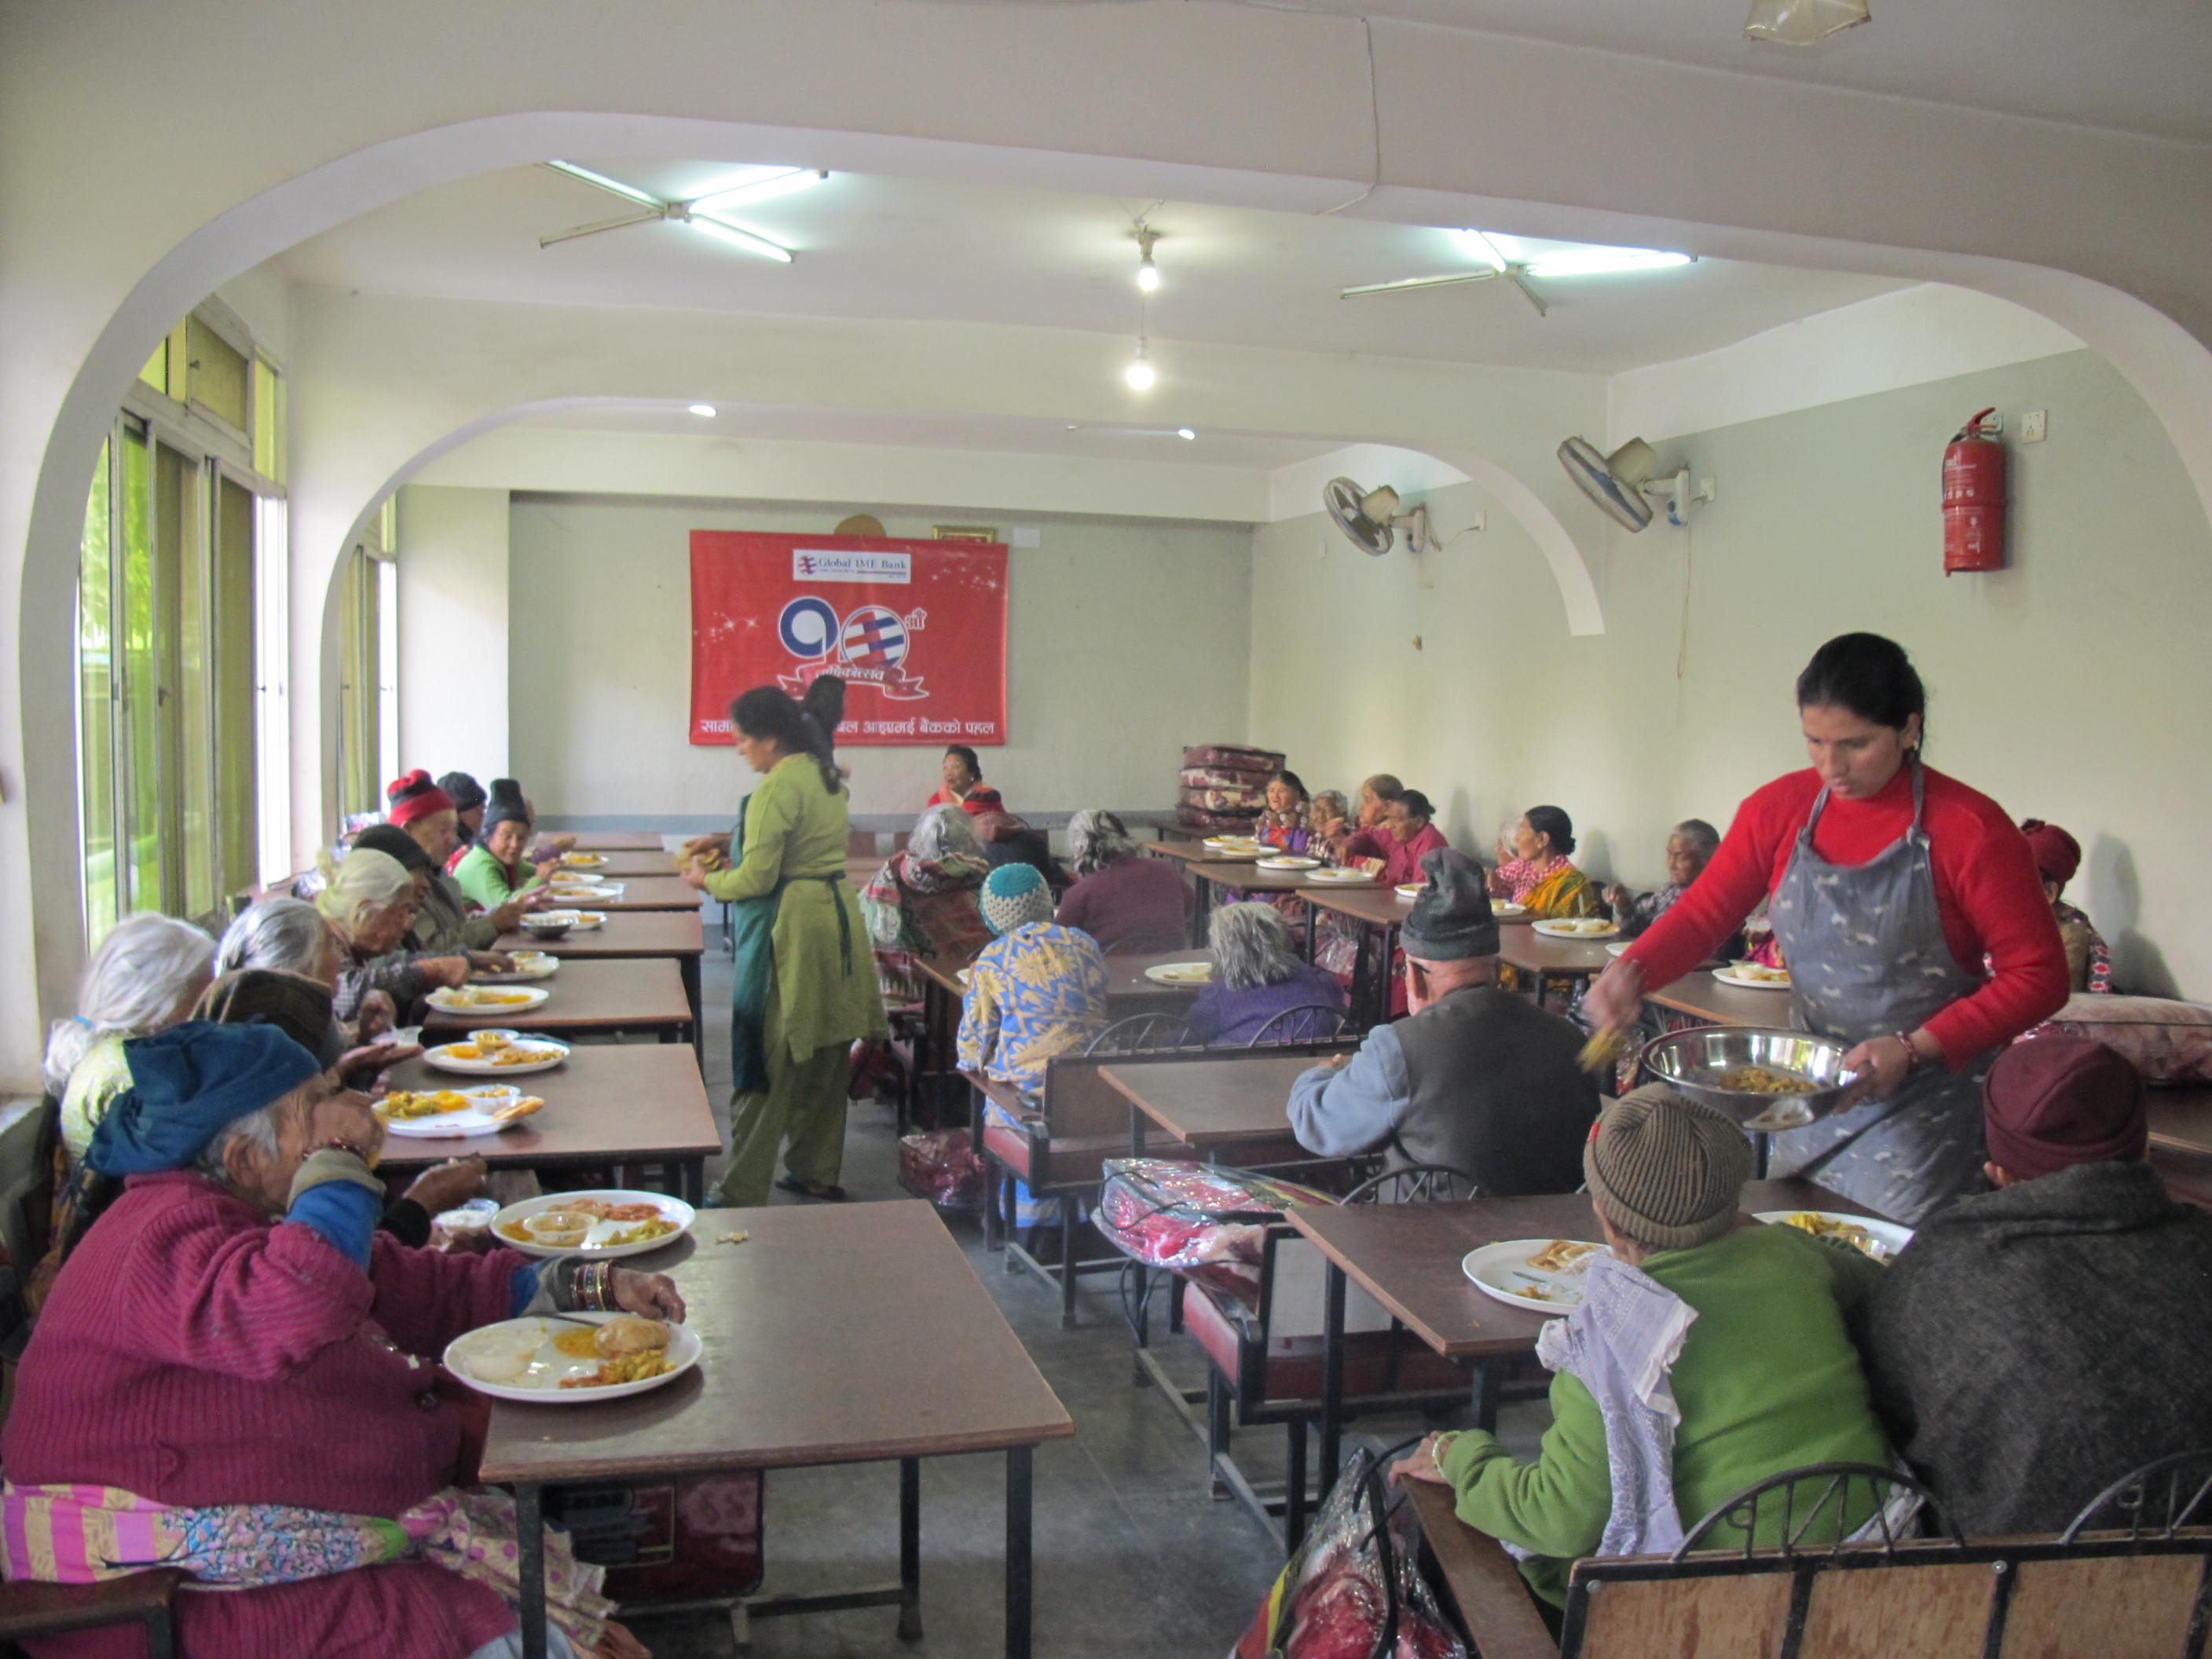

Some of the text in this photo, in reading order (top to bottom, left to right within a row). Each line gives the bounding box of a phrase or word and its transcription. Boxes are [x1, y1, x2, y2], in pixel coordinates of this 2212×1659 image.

[819, 558, 907, 569] Global IME Bank
[965, 722, 994, 735] पहल
